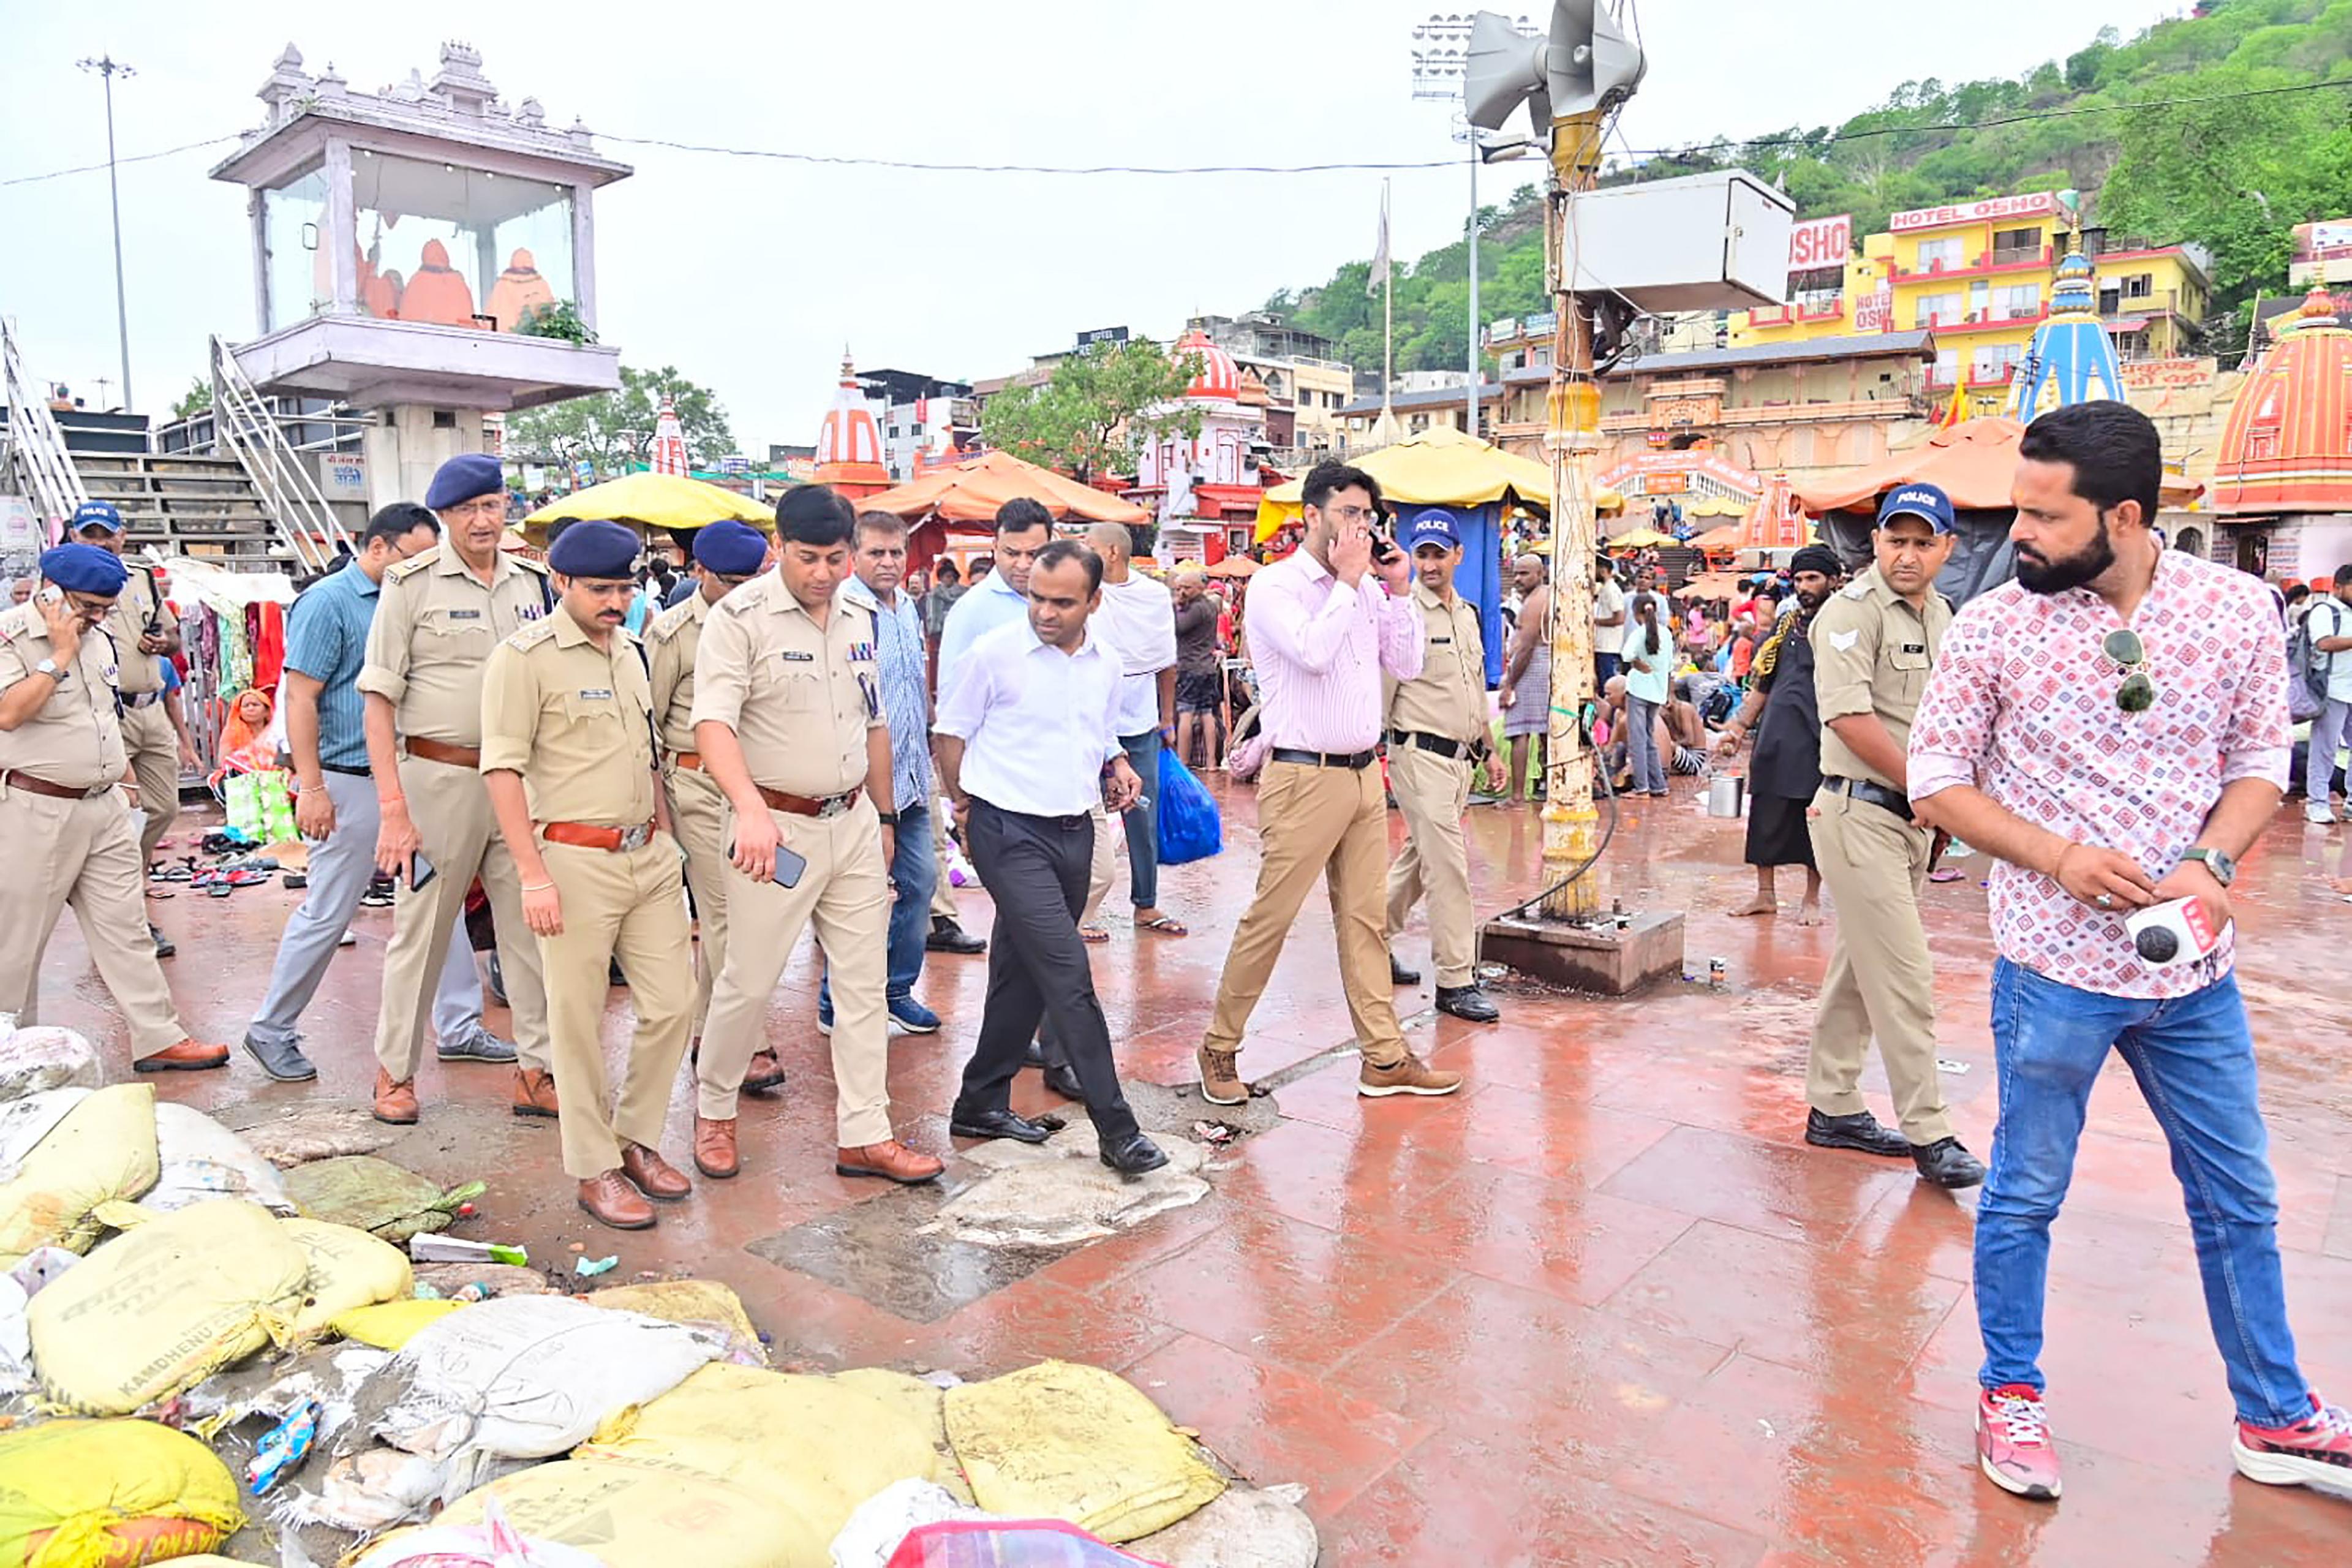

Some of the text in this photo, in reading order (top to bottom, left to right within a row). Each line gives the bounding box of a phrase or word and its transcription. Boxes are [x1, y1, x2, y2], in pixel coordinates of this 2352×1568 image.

[1894, 195, 2047, 227] HOTEL OSHO
[1896, 491, 1937, 507] POLICE
[1415, 519, 1449, 532] POLICE
[118, 1325, 214, 1397] KAMDHENU
